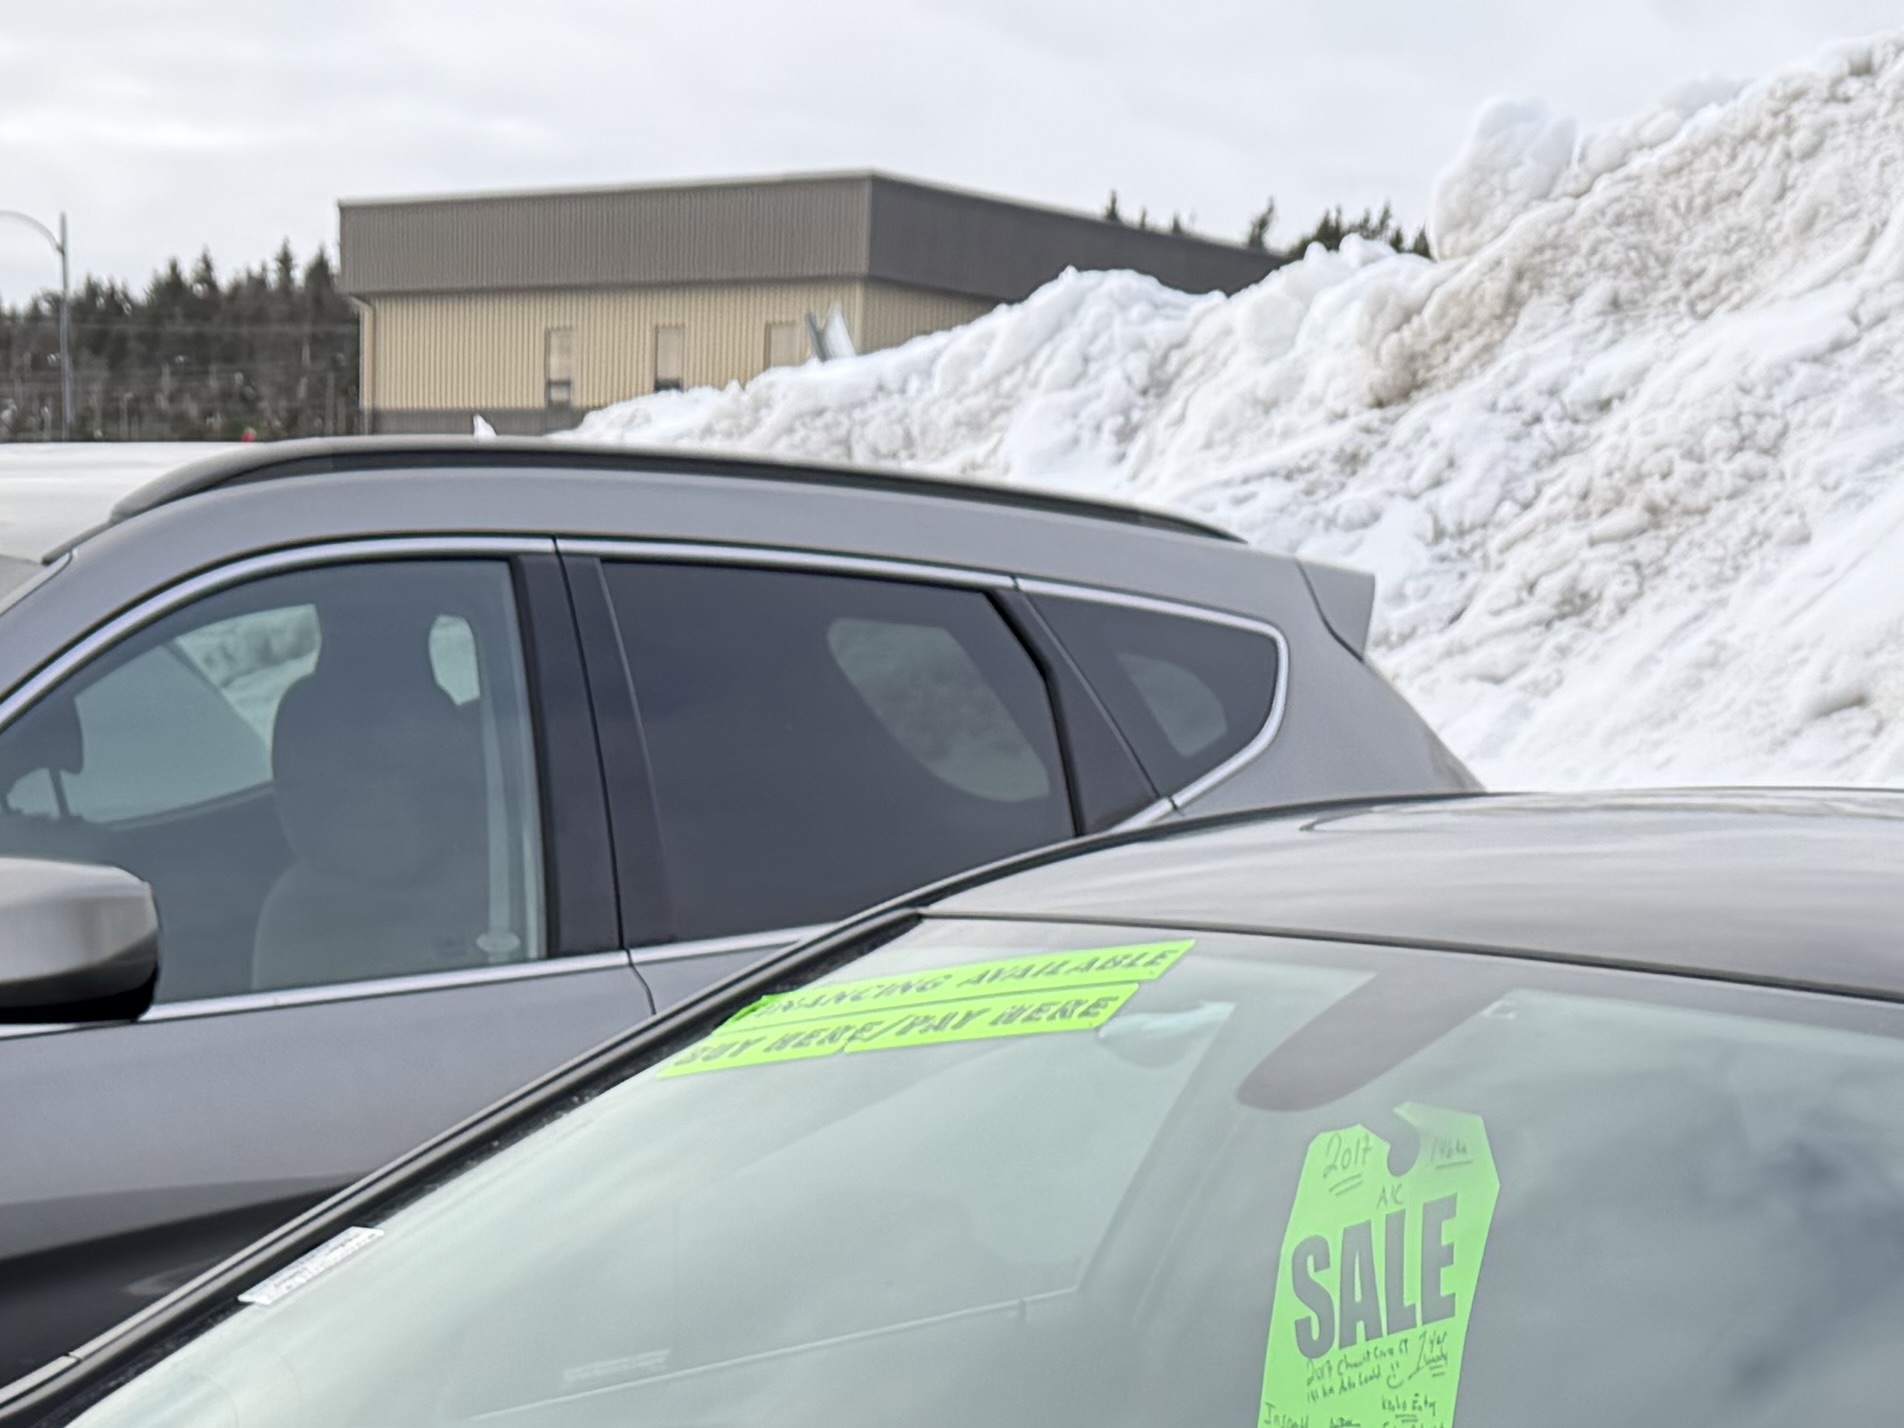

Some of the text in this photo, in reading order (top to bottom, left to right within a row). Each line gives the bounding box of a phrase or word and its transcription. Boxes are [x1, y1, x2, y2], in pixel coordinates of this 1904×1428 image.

[748, 948, 1180, 1018] INANCING AVAILABLE
[673, 1035, 767, 1067] BUY
[988, 995, 1119, 1027] HERE
[1322, 1132, 1372, 1179] 2017
[1291, 1191, 1458, 1360] SALE
